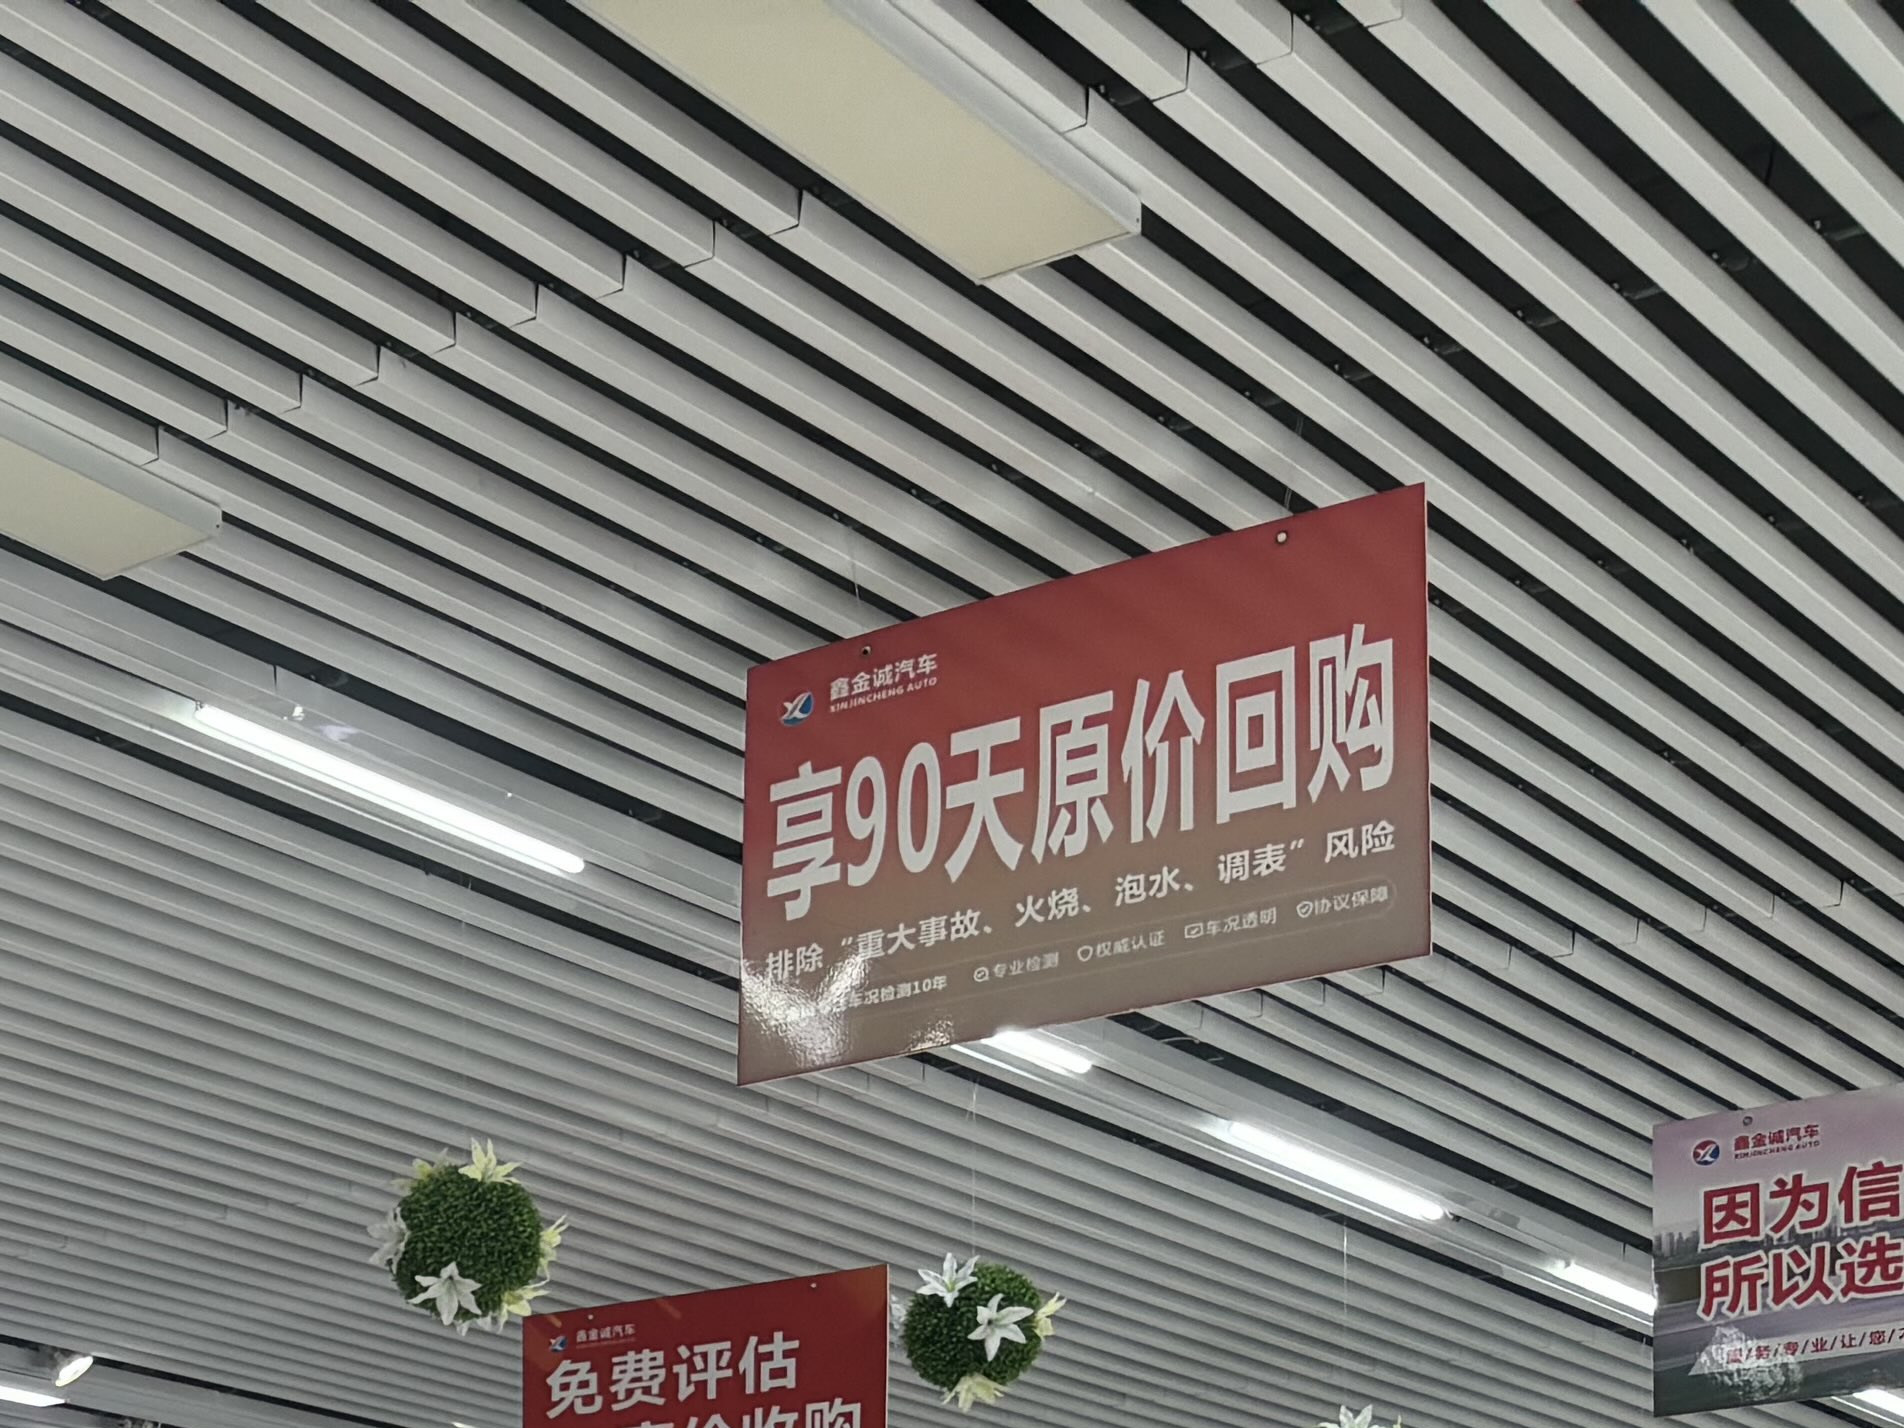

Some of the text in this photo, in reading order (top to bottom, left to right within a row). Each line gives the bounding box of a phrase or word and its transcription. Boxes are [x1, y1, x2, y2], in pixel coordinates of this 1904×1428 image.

[830, 653, 938, 701] 鑫金诚汽车
[830, 676, 938, 713] XINJINCHENG AUTO
[766, 623, 1395, 922] 享90天原价回购
[992, 951, 1060, 980] 专业检测
[1095, 929, 1166, 960] 权威认证
[1206, 907, 1278, 938] 车况透明
[1314, 884, 1390, 917] 协议保障
[545, 1331, 801, 1420] 免费评估
